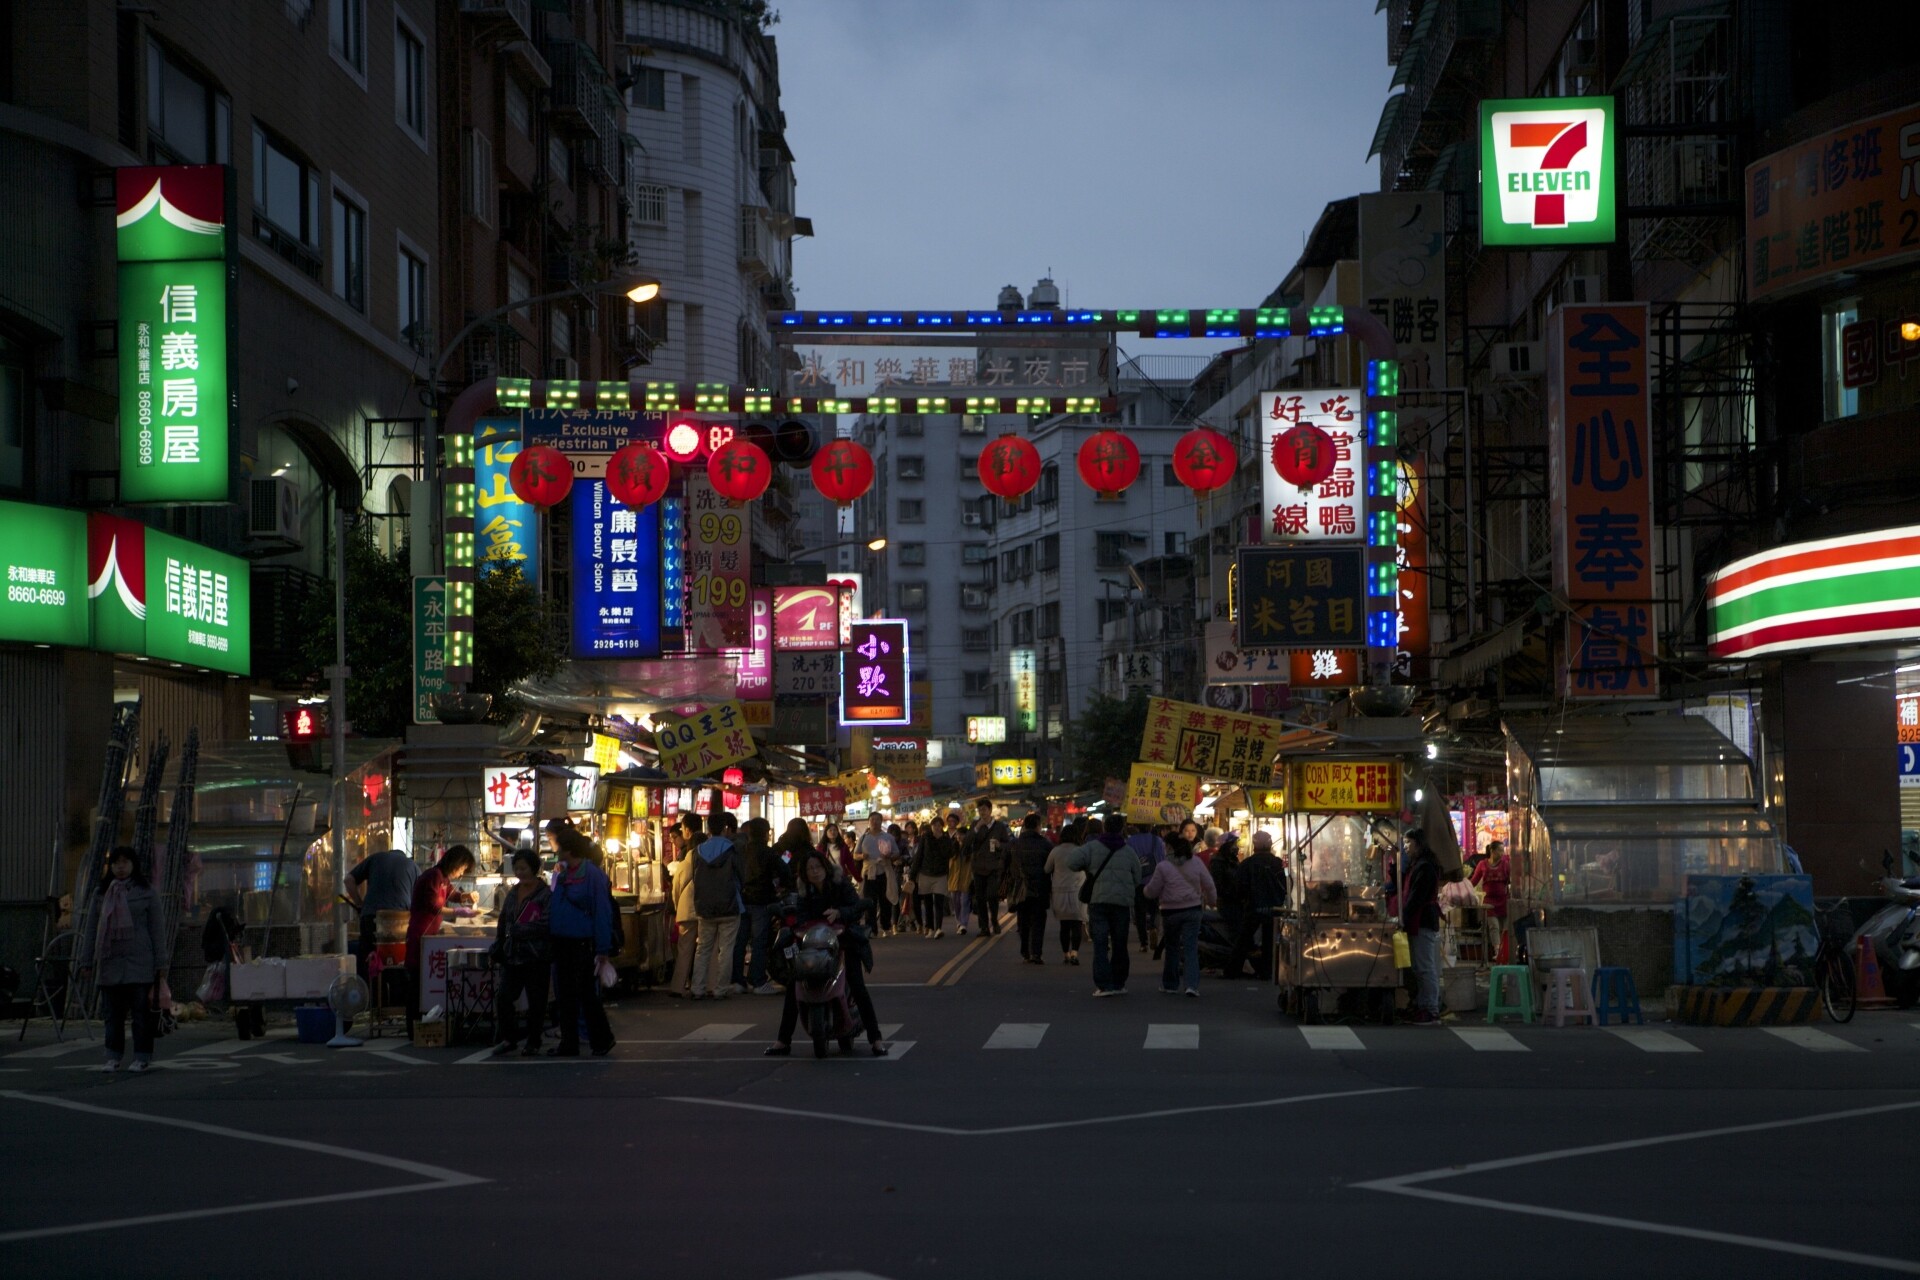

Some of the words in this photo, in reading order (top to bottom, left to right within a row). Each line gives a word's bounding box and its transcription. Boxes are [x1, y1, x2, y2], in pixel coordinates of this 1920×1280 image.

[137, 323, 151, 385] 永和樂華店
[798, 349, 1090, 387] 永和樂華觀光夜市
[159, 284, 200, 464] 信義房屋
[1271, 394, 1354, 423] 好吃
[138, 391, 152, 465] 8660-6699
[561, 424, 629, 436] Exclusive
[520, 453, 558, 487] 永
[719, 450, 757, 482] 和
[822, 448, 859, 485] 平
[593, 481, 603, 519] William
[1569, 312, 1648, 690] 全心奉獻
[593, 523, 603, 560] Beauty
[610, 492, 638, 592] 廉髮藝
[700, 513, 742, 545] 99
[8, 565, 55, 586] 永和樂華店
[594, 563, 604, 592] Salon
[693, 551, 740, 571] 剪髮
[1265, 557, 1333, 589] 阿國
[8, 586, 66, 606] 8660-6699
[164, 557, 228, 627] 信義房屋
[693, 575, 747, 608] 199
[424, 595, 445, 671] 永平路
[793, 678, 815, 691] 270
[1149, 699, 1176, 761] 水煮玉米
[1187, 710, 1275, 740] 樂華阿文
[1218, 759, 1271, 784] 石頭玉米
[1305, 764, 1329, 784] CORN
[1355, 765, 1398, 803] 石頭玉米
